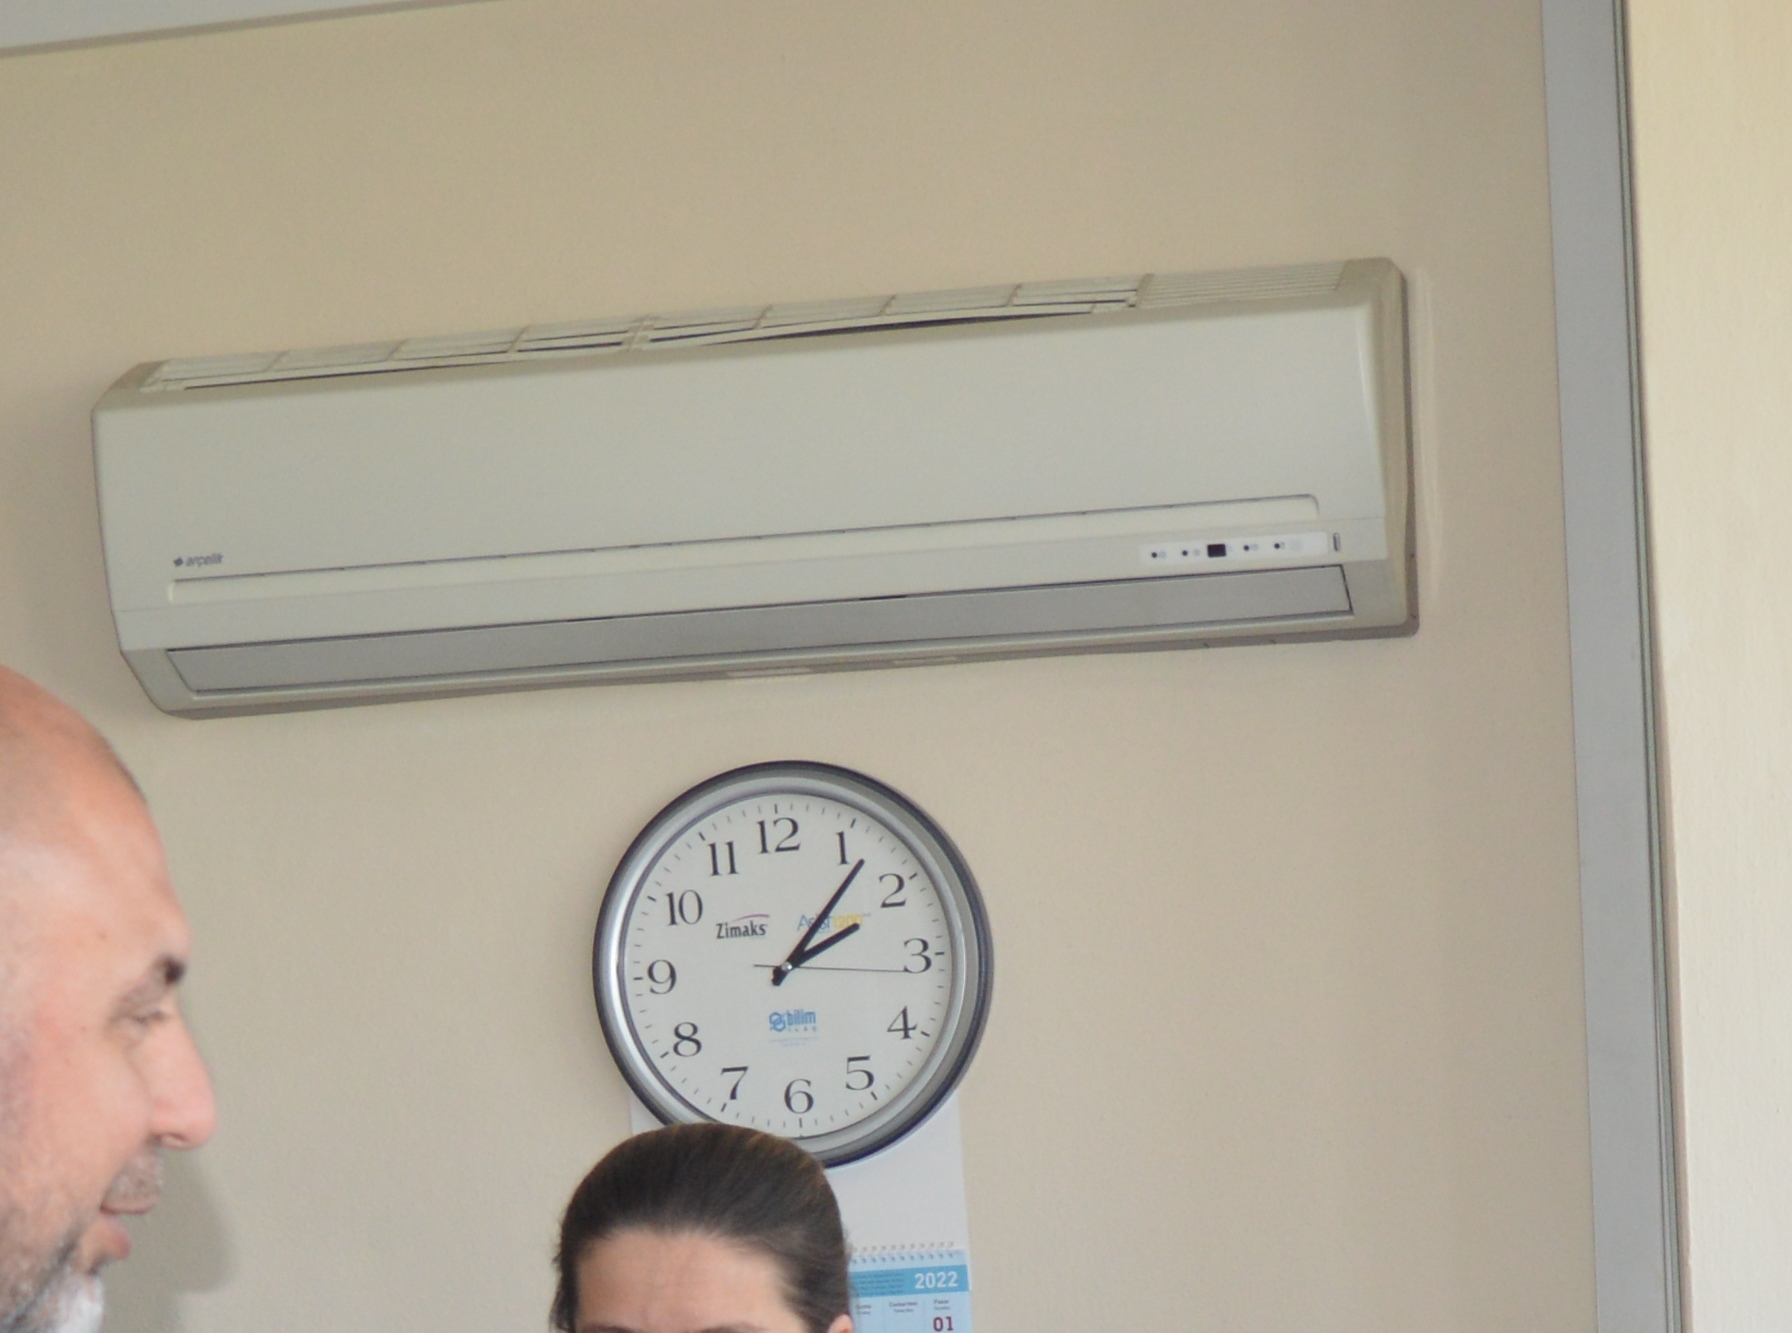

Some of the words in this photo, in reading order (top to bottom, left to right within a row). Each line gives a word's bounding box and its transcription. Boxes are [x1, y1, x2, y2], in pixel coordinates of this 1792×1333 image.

[756, 817, 801, 855] 12
[835, 831, 850, 865] 1
[709, 842, 738, 876] 11
[665, 889, 703, 925] 10
[878, 873, 907, 909] 2
[715, 919, 768, 939] Zimaks
[903, 938, 932, 974] 3
[647, 960, 676, 995] 9
[786, 1009, 816, 1026] bilim
[887, 1007, 917, 1040] 4
[672, 1023, 702, 1057] 8
[720, 1066, 749, 1100] 7
[845, 1056, 874, 1091] 5
[784, 1079, 814, 1115] 6
[914, 1271, 958, 1289] 2022
[933, 1316, 954, 1332] 01
